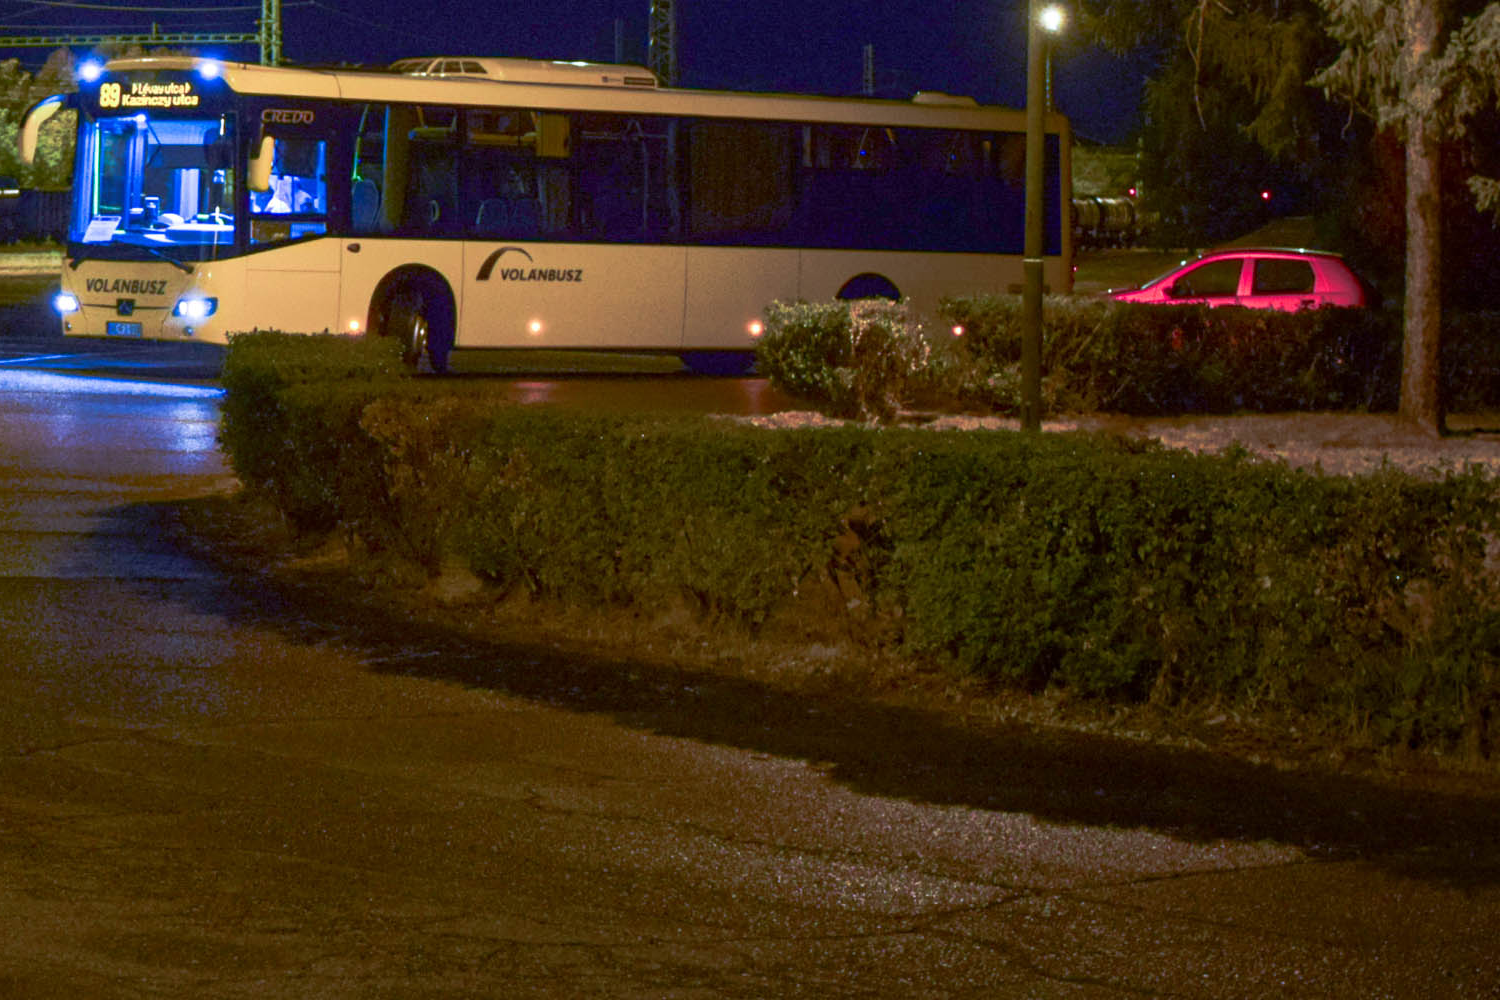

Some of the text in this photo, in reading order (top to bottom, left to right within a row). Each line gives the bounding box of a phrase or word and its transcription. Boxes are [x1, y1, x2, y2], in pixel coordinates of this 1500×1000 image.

[100, 83, 121, 107] 89
[122, 94, 199, 107] Kazinczy utca
[261, 109, 315, 124] CREDO
